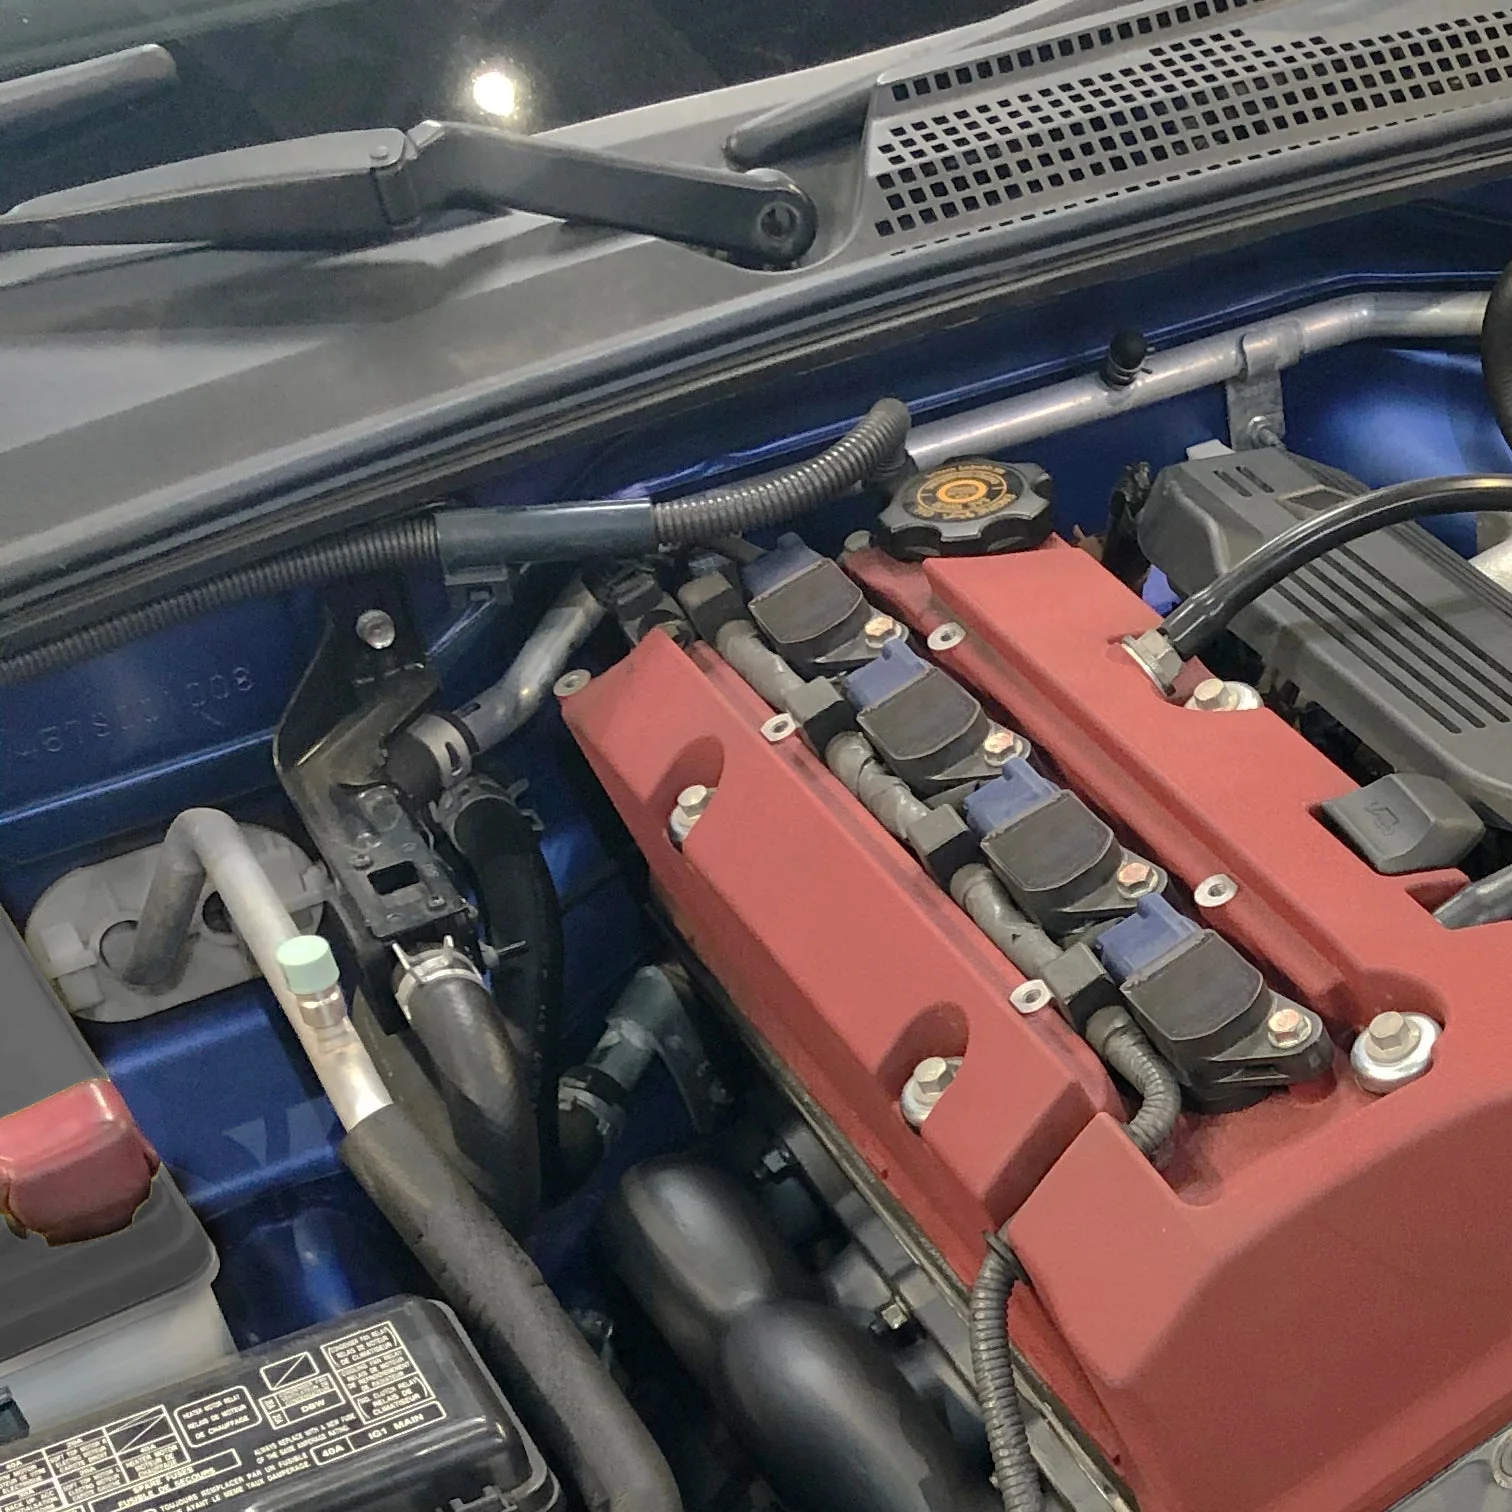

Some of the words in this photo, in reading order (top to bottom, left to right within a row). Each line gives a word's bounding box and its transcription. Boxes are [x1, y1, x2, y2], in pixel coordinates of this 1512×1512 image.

[402, 1388, 413, 1396] DE
[394, 1413, 424, 1429] MAIN
[322, 1444, 345, 1457] 40A
[133, 1479, 162, 1493] SPARE
[158, 1484, 171, 1493] DE
[160, 1494, 198, 1512] TOUJOURS
[247, 1469, 262, 1479] PAR
[264, 1464, 275, 1472] UN
[246, 1478, 265, 1489] TAUX
